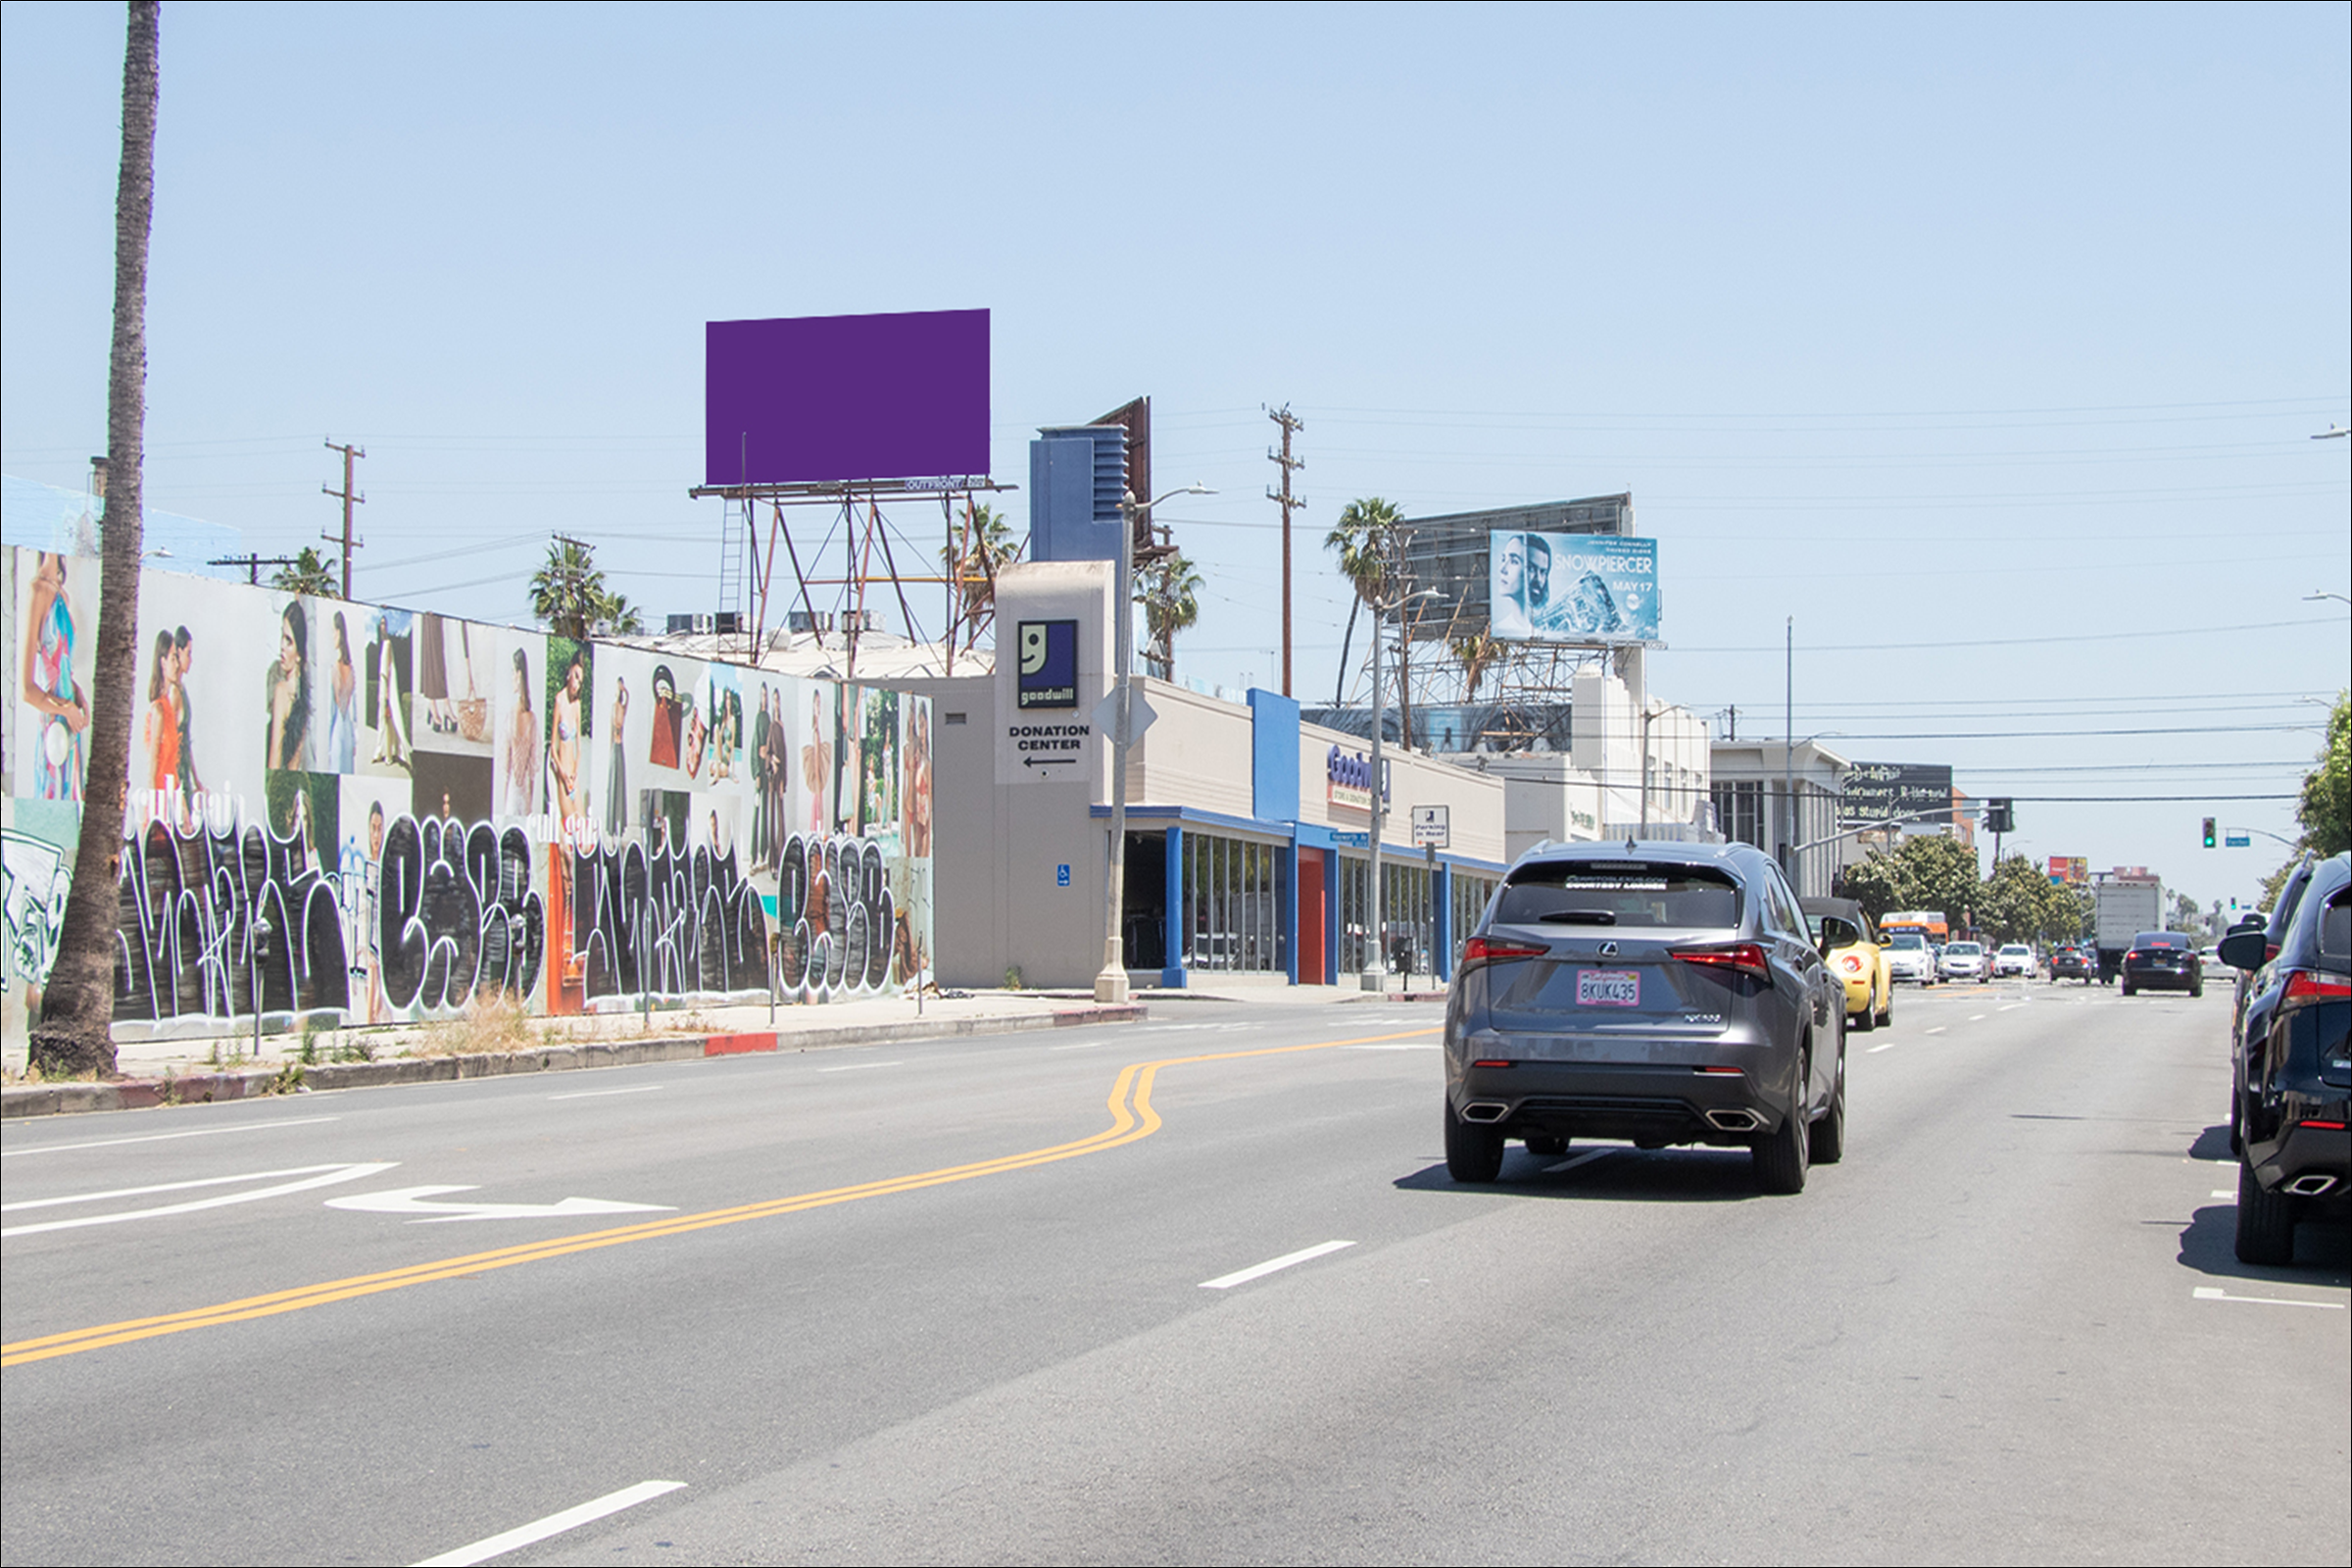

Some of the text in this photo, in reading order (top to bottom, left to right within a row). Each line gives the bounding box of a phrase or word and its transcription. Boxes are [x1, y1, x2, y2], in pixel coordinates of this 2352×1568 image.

[906, 477, 962, 490] OUTFRONT
[1553, 553, 1653, 574] SNOWPIERCER
[1612, 581, 1653, 593] MAY 17
[1021, 688, 1074, 706] goodwill
[1008, 725, 1090, 737] DONATION
[1017, 739, 1081, 751] CENTER
[1327, 744, 1373, 789] Goodw
[1581, 982, 1637, 1001] 8KUK435
